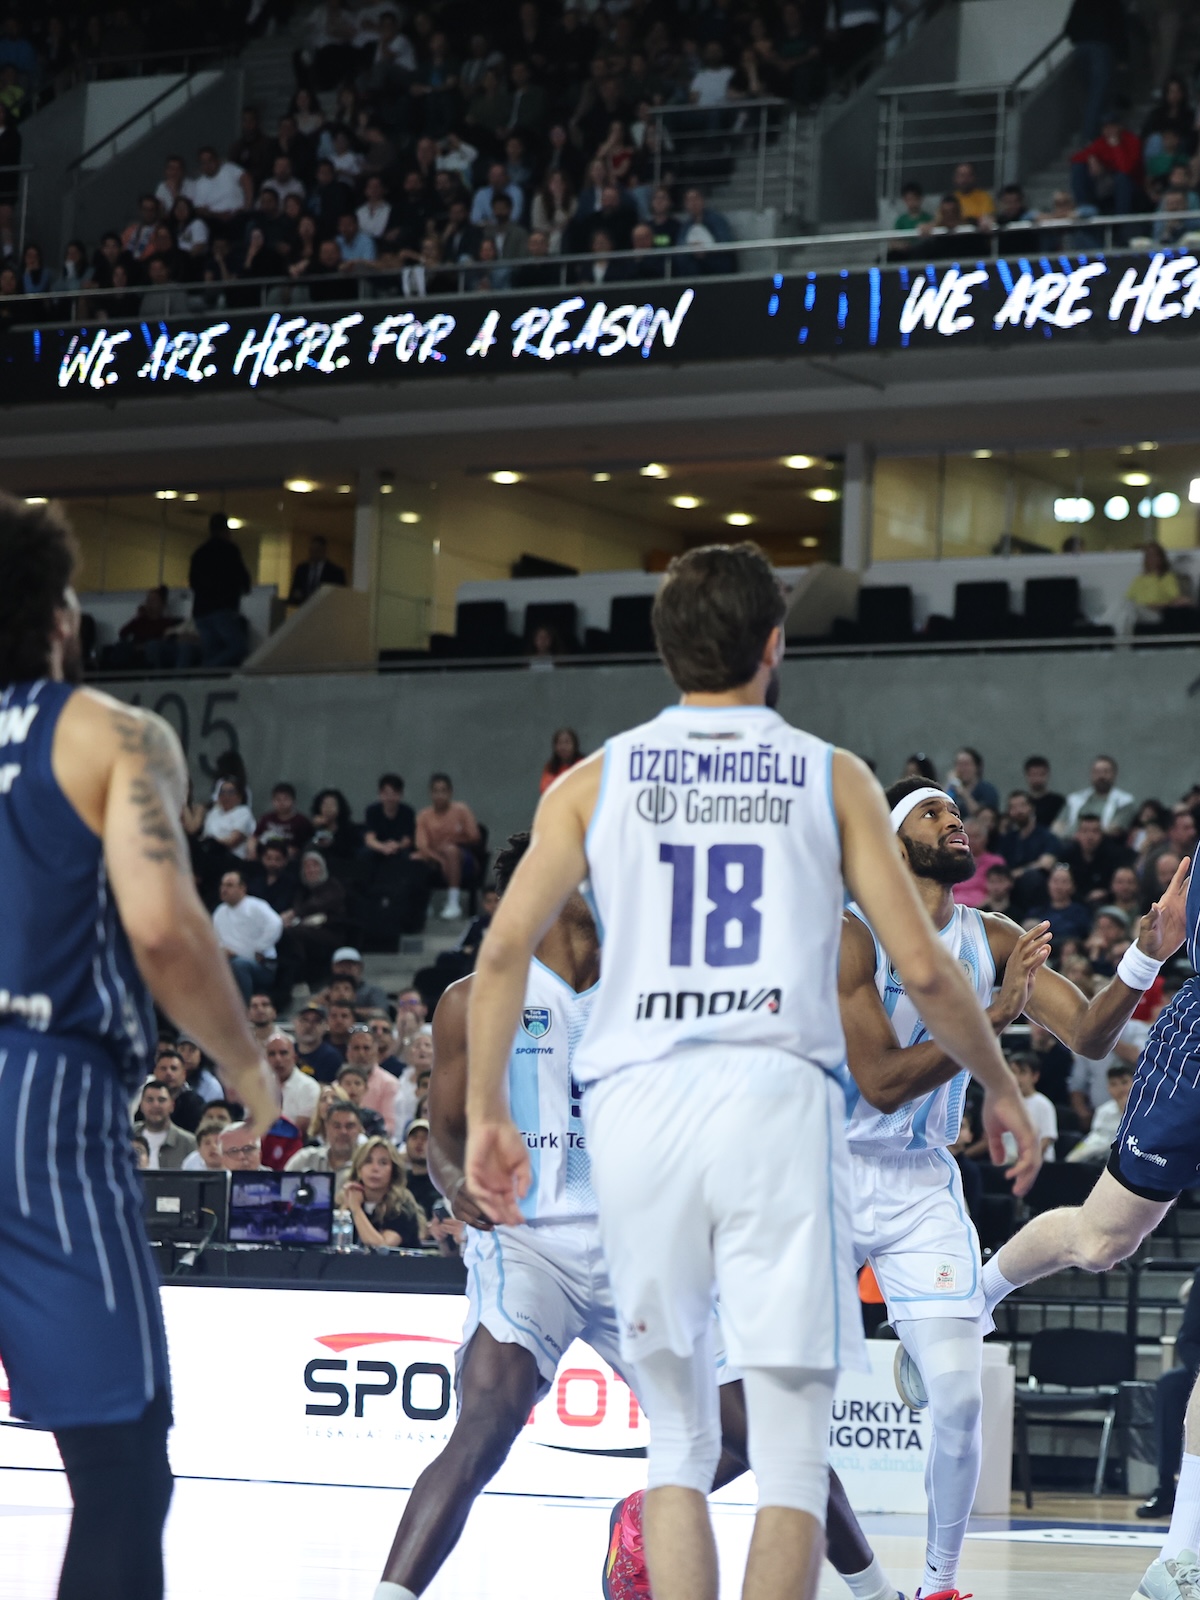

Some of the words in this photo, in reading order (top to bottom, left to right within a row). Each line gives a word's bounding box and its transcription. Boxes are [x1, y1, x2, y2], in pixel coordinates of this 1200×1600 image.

[899, 269, 989, 336] WE
[994, 261, 1109, 329] ARE
[57, 328, 132, 389] WE
[138, 321, 231, 383] ARE
[233, 311, 365, 388] HERE
[368, 312, 456, 364] FOR
[466, 309, 502, 357] A
[511, 287, 696, 360] REASON
[685, 788, 795, 826] Gamador
[659, 843, 764, 968] 18
[515, 1047, 555, 1055] SPORTIVE
